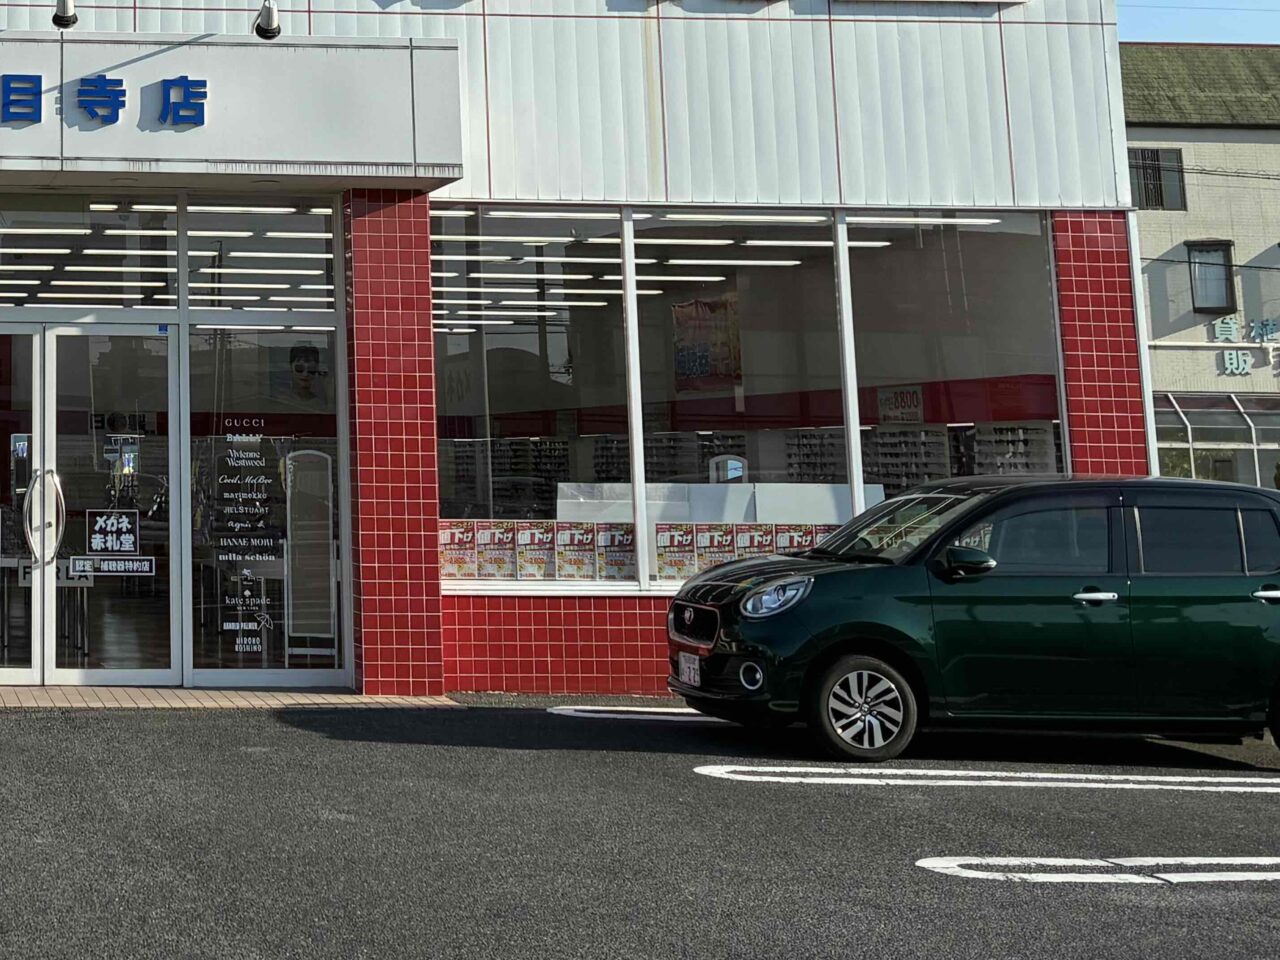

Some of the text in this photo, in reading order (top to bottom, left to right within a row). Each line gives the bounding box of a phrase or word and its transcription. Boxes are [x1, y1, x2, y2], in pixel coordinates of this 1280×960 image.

[225, 419, 264, 427] GUCCI
[228, 449, 260, 458] Vivienne
[225, 458, 265, 467] Westwood
[94, 515, 132, 531] メガネ
[91, 533, 135, 551] 赤札堂
[220, 538, 273, 546] HANAE MORI
[225, 596, 271, 606] kate spade
